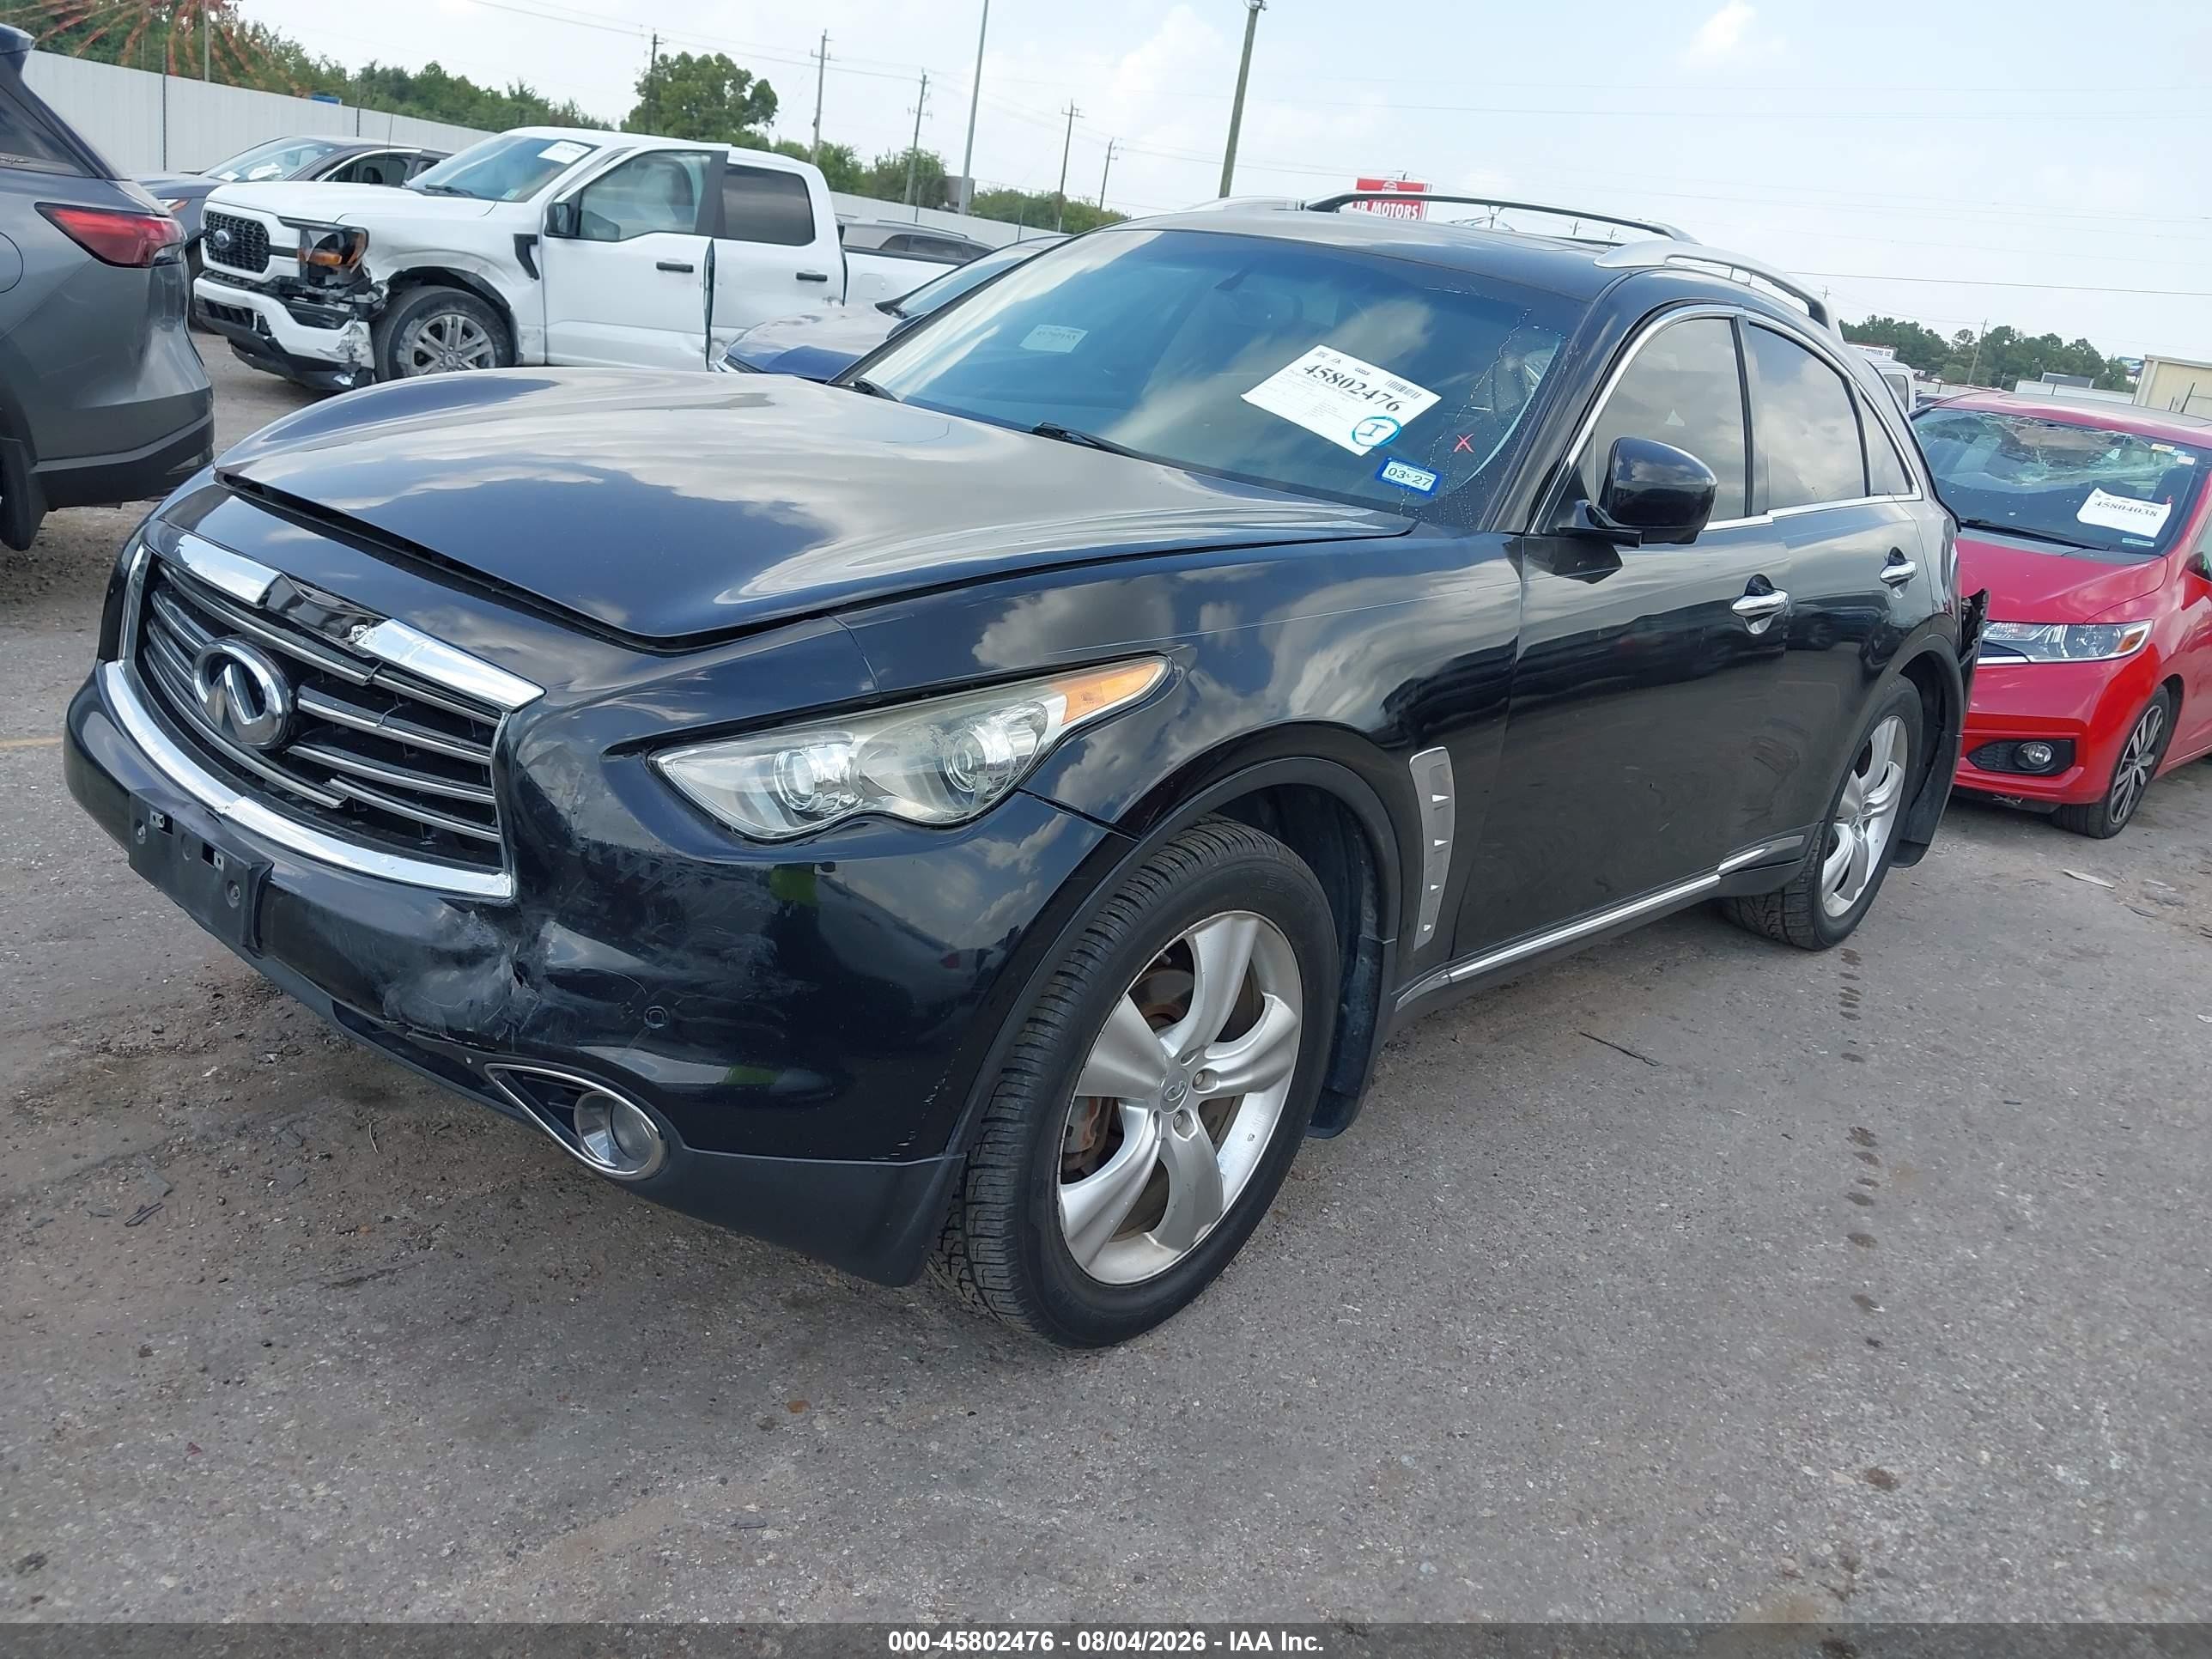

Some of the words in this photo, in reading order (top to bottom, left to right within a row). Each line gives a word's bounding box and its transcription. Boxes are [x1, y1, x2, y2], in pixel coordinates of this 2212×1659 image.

[1371, 201, 1419, 220] MOTORS
[1304, 365, 1406, 411] 45802476
[2095, 501, 2158, 517] 45804038
